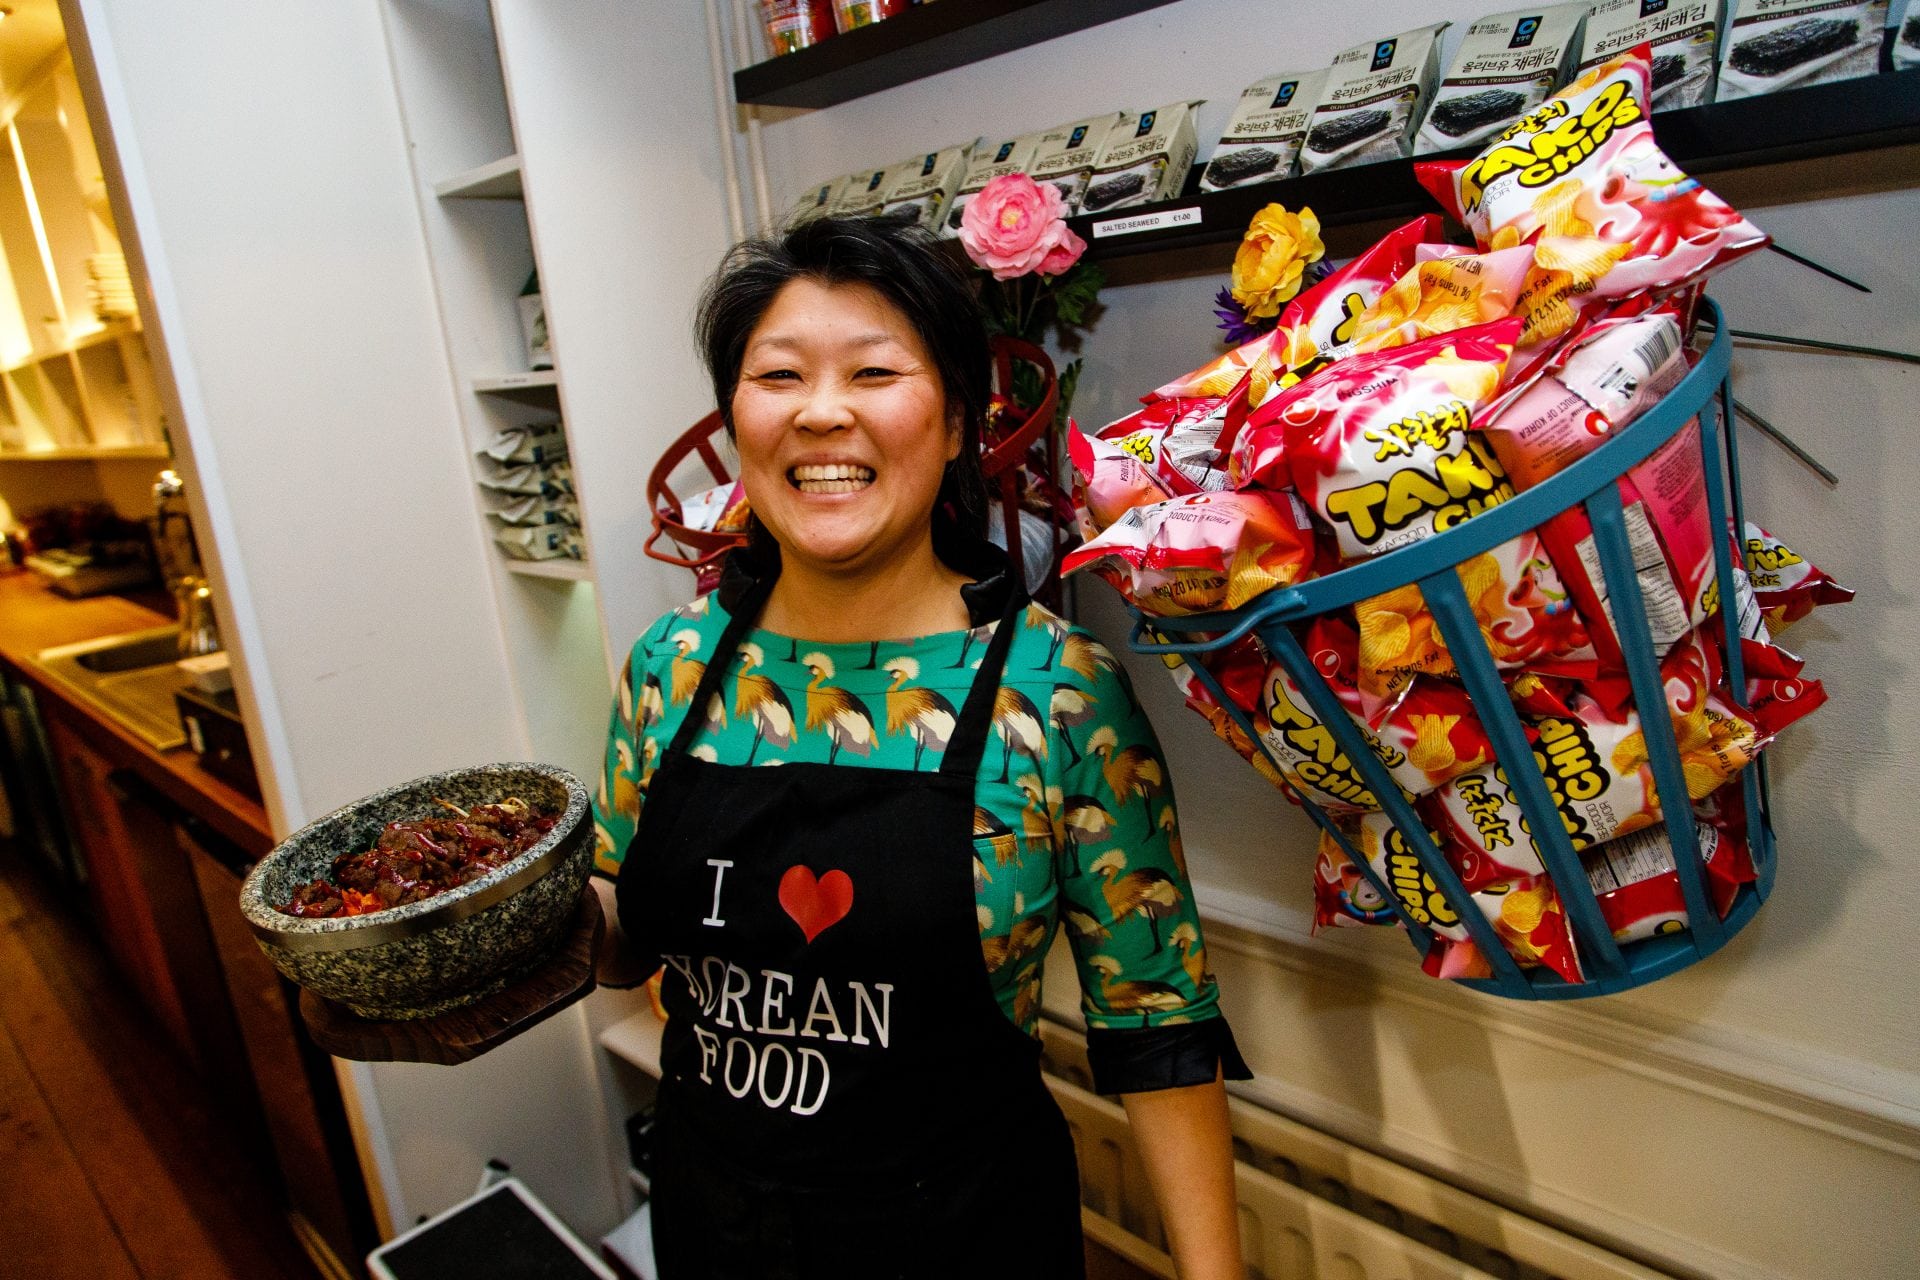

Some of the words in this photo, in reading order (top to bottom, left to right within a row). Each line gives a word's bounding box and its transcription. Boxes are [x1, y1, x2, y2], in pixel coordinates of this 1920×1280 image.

[1651, 4, 1707, 32] 재래김
[1511, 48, 1560, 71] 재래김
[1461, 78, 1634, 216] TAKO
[1518, 95, 1643, 187] CHIPS
[1102, 223, 1127, 233] SALTED
[1127, 217, 1160, 229] SEAWEED
[1439, 278, 1460, 297] Trans
[1534, 275, 1553, 291] Fat
[1519, 416, 1547, 440] KOREA
[1386, 673, 1403, 692] NET
[1456, 774, 1514, 851] 자갈치
[702, 858, 734, 927] I
[660, 953, 895, 1049] KOREAN
[693, 1023, 831, 1117] FOOD
